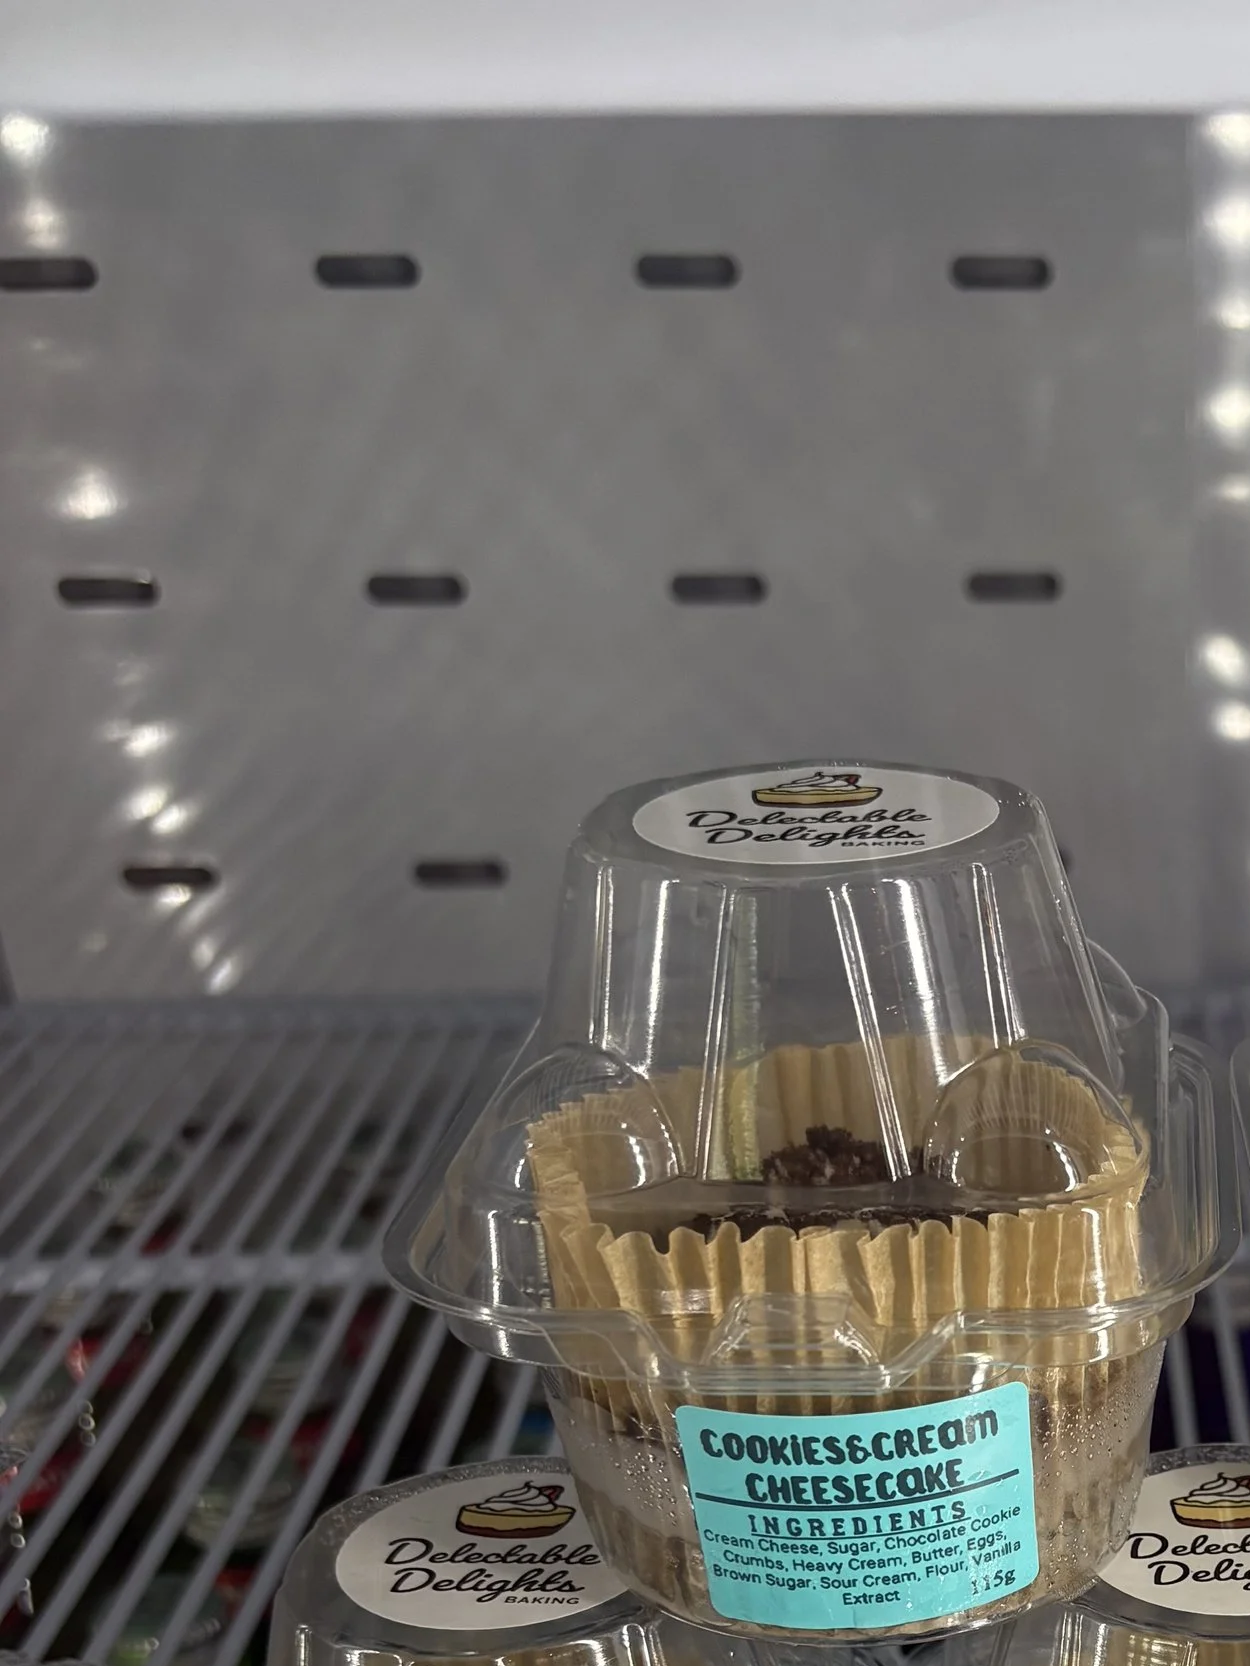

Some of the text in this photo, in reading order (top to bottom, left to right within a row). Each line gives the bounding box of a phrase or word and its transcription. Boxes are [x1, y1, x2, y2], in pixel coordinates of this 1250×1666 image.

[686, 808, 932, 829] Delectable
[705, 824, 925, 847] Delights
[704, 1505, 1021, 1556] Cream Cheese, Sugar, Chocolate Cookie
[748, 1501, 966, 1537] INGREDIENTS
[384, 1537, 601, 1565] Delectable
[713, 1540, 1021, 1590] Brown Sugar, Sour Cream, Flour, Vanilla
[723, 1530, 1007, 1574] Crumbs, Heavy Cream, Butter, Eggs,
[390, 1567, 585, 1603] Delights
[504, 1596, 579, 1605] BAKING
[842, 1590, 901, 1605] Extract
